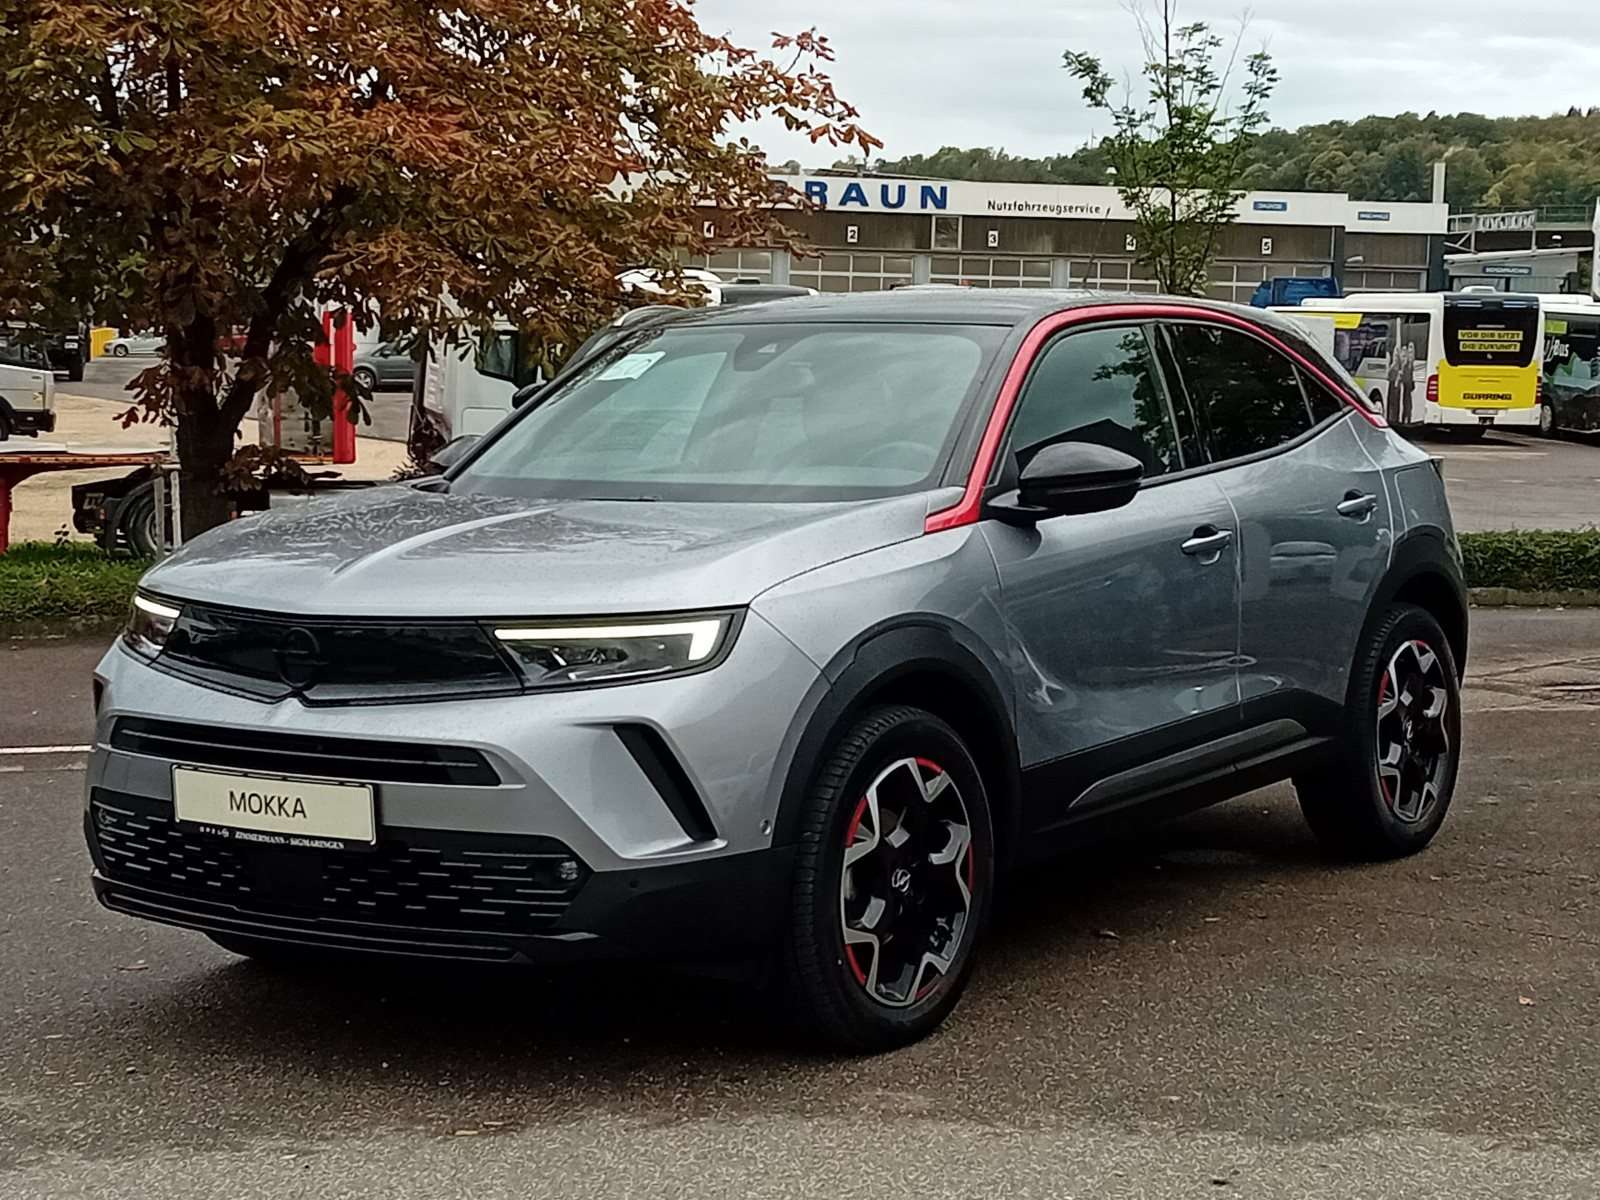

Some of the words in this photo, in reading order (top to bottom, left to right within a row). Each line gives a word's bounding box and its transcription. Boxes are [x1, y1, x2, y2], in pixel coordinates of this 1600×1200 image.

[769, 179, 948, 210] RAUN
[987, 199, 1101, 215] Nutzfahrzeugservice
[228, 790, 307, 819] MOKKA
